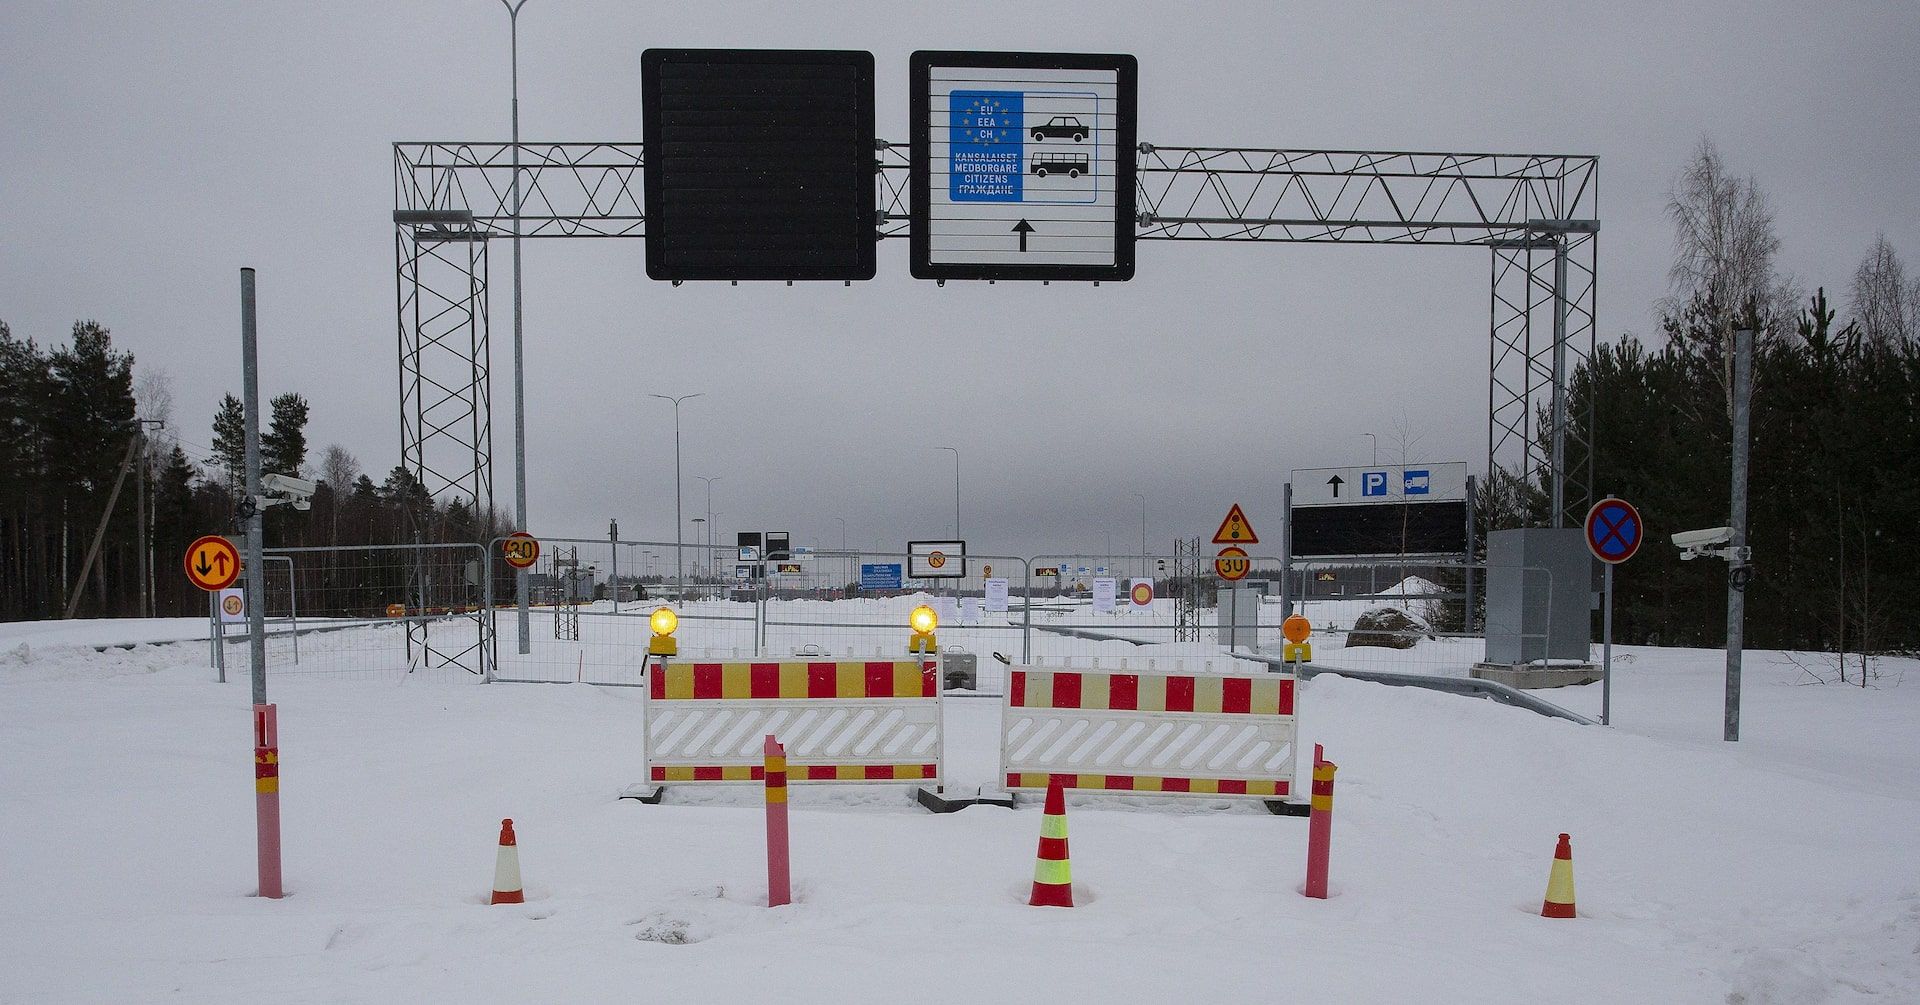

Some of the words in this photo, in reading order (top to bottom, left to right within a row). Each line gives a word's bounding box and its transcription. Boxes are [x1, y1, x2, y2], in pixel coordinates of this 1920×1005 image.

[980, 105, 993, 115] EU
[977, 118, 996, 127] EEA
[980, 130, 993, 139] CH
[955, 153, 1018, 162] KANSALAISET
[955, 163, 1018, 173] MEDBORGARE
[964, 174, 1008, 184] CITIZENS
[959, 185, 1014, 195] ГРАЖДАНЕ
[1368, 474, 1384, 495] P
[1221, 557, 1243, 573] 30
